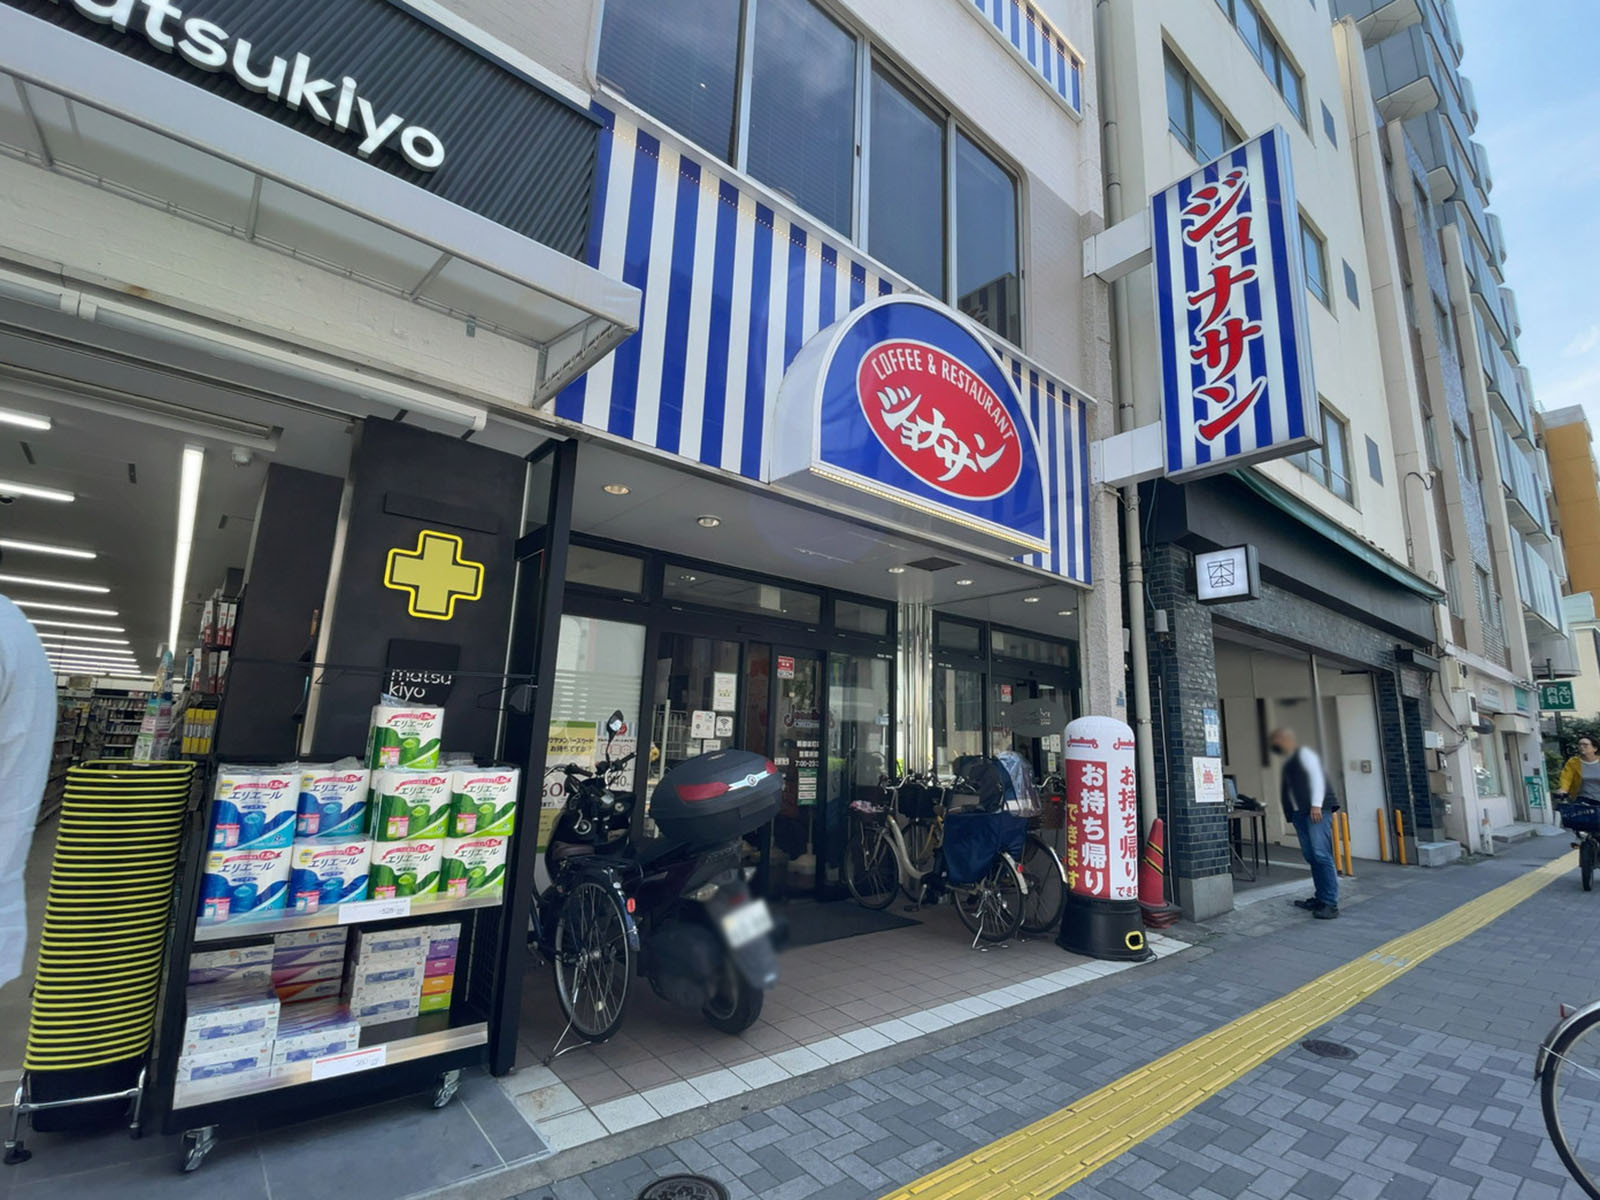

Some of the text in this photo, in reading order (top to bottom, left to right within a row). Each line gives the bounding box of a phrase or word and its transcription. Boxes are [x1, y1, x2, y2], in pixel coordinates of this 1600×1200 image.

[55, 0, 446, 172] atsukiyo
[1181, 168, 1266, 442] ジョナサン
[871, 348, 1015, 440] COFFEE & RESTAURANT
[876, 385, 1006, 482] ジョナサン
[389, 681, 426, 701] kiyo
[391, 669, 452, 685] matsu
[1067, 803, 1080, 890] できます
[1080, 763, 1107, 896] お持ち帰り
[1118, 766, 1137, 882] お持ち帰り
